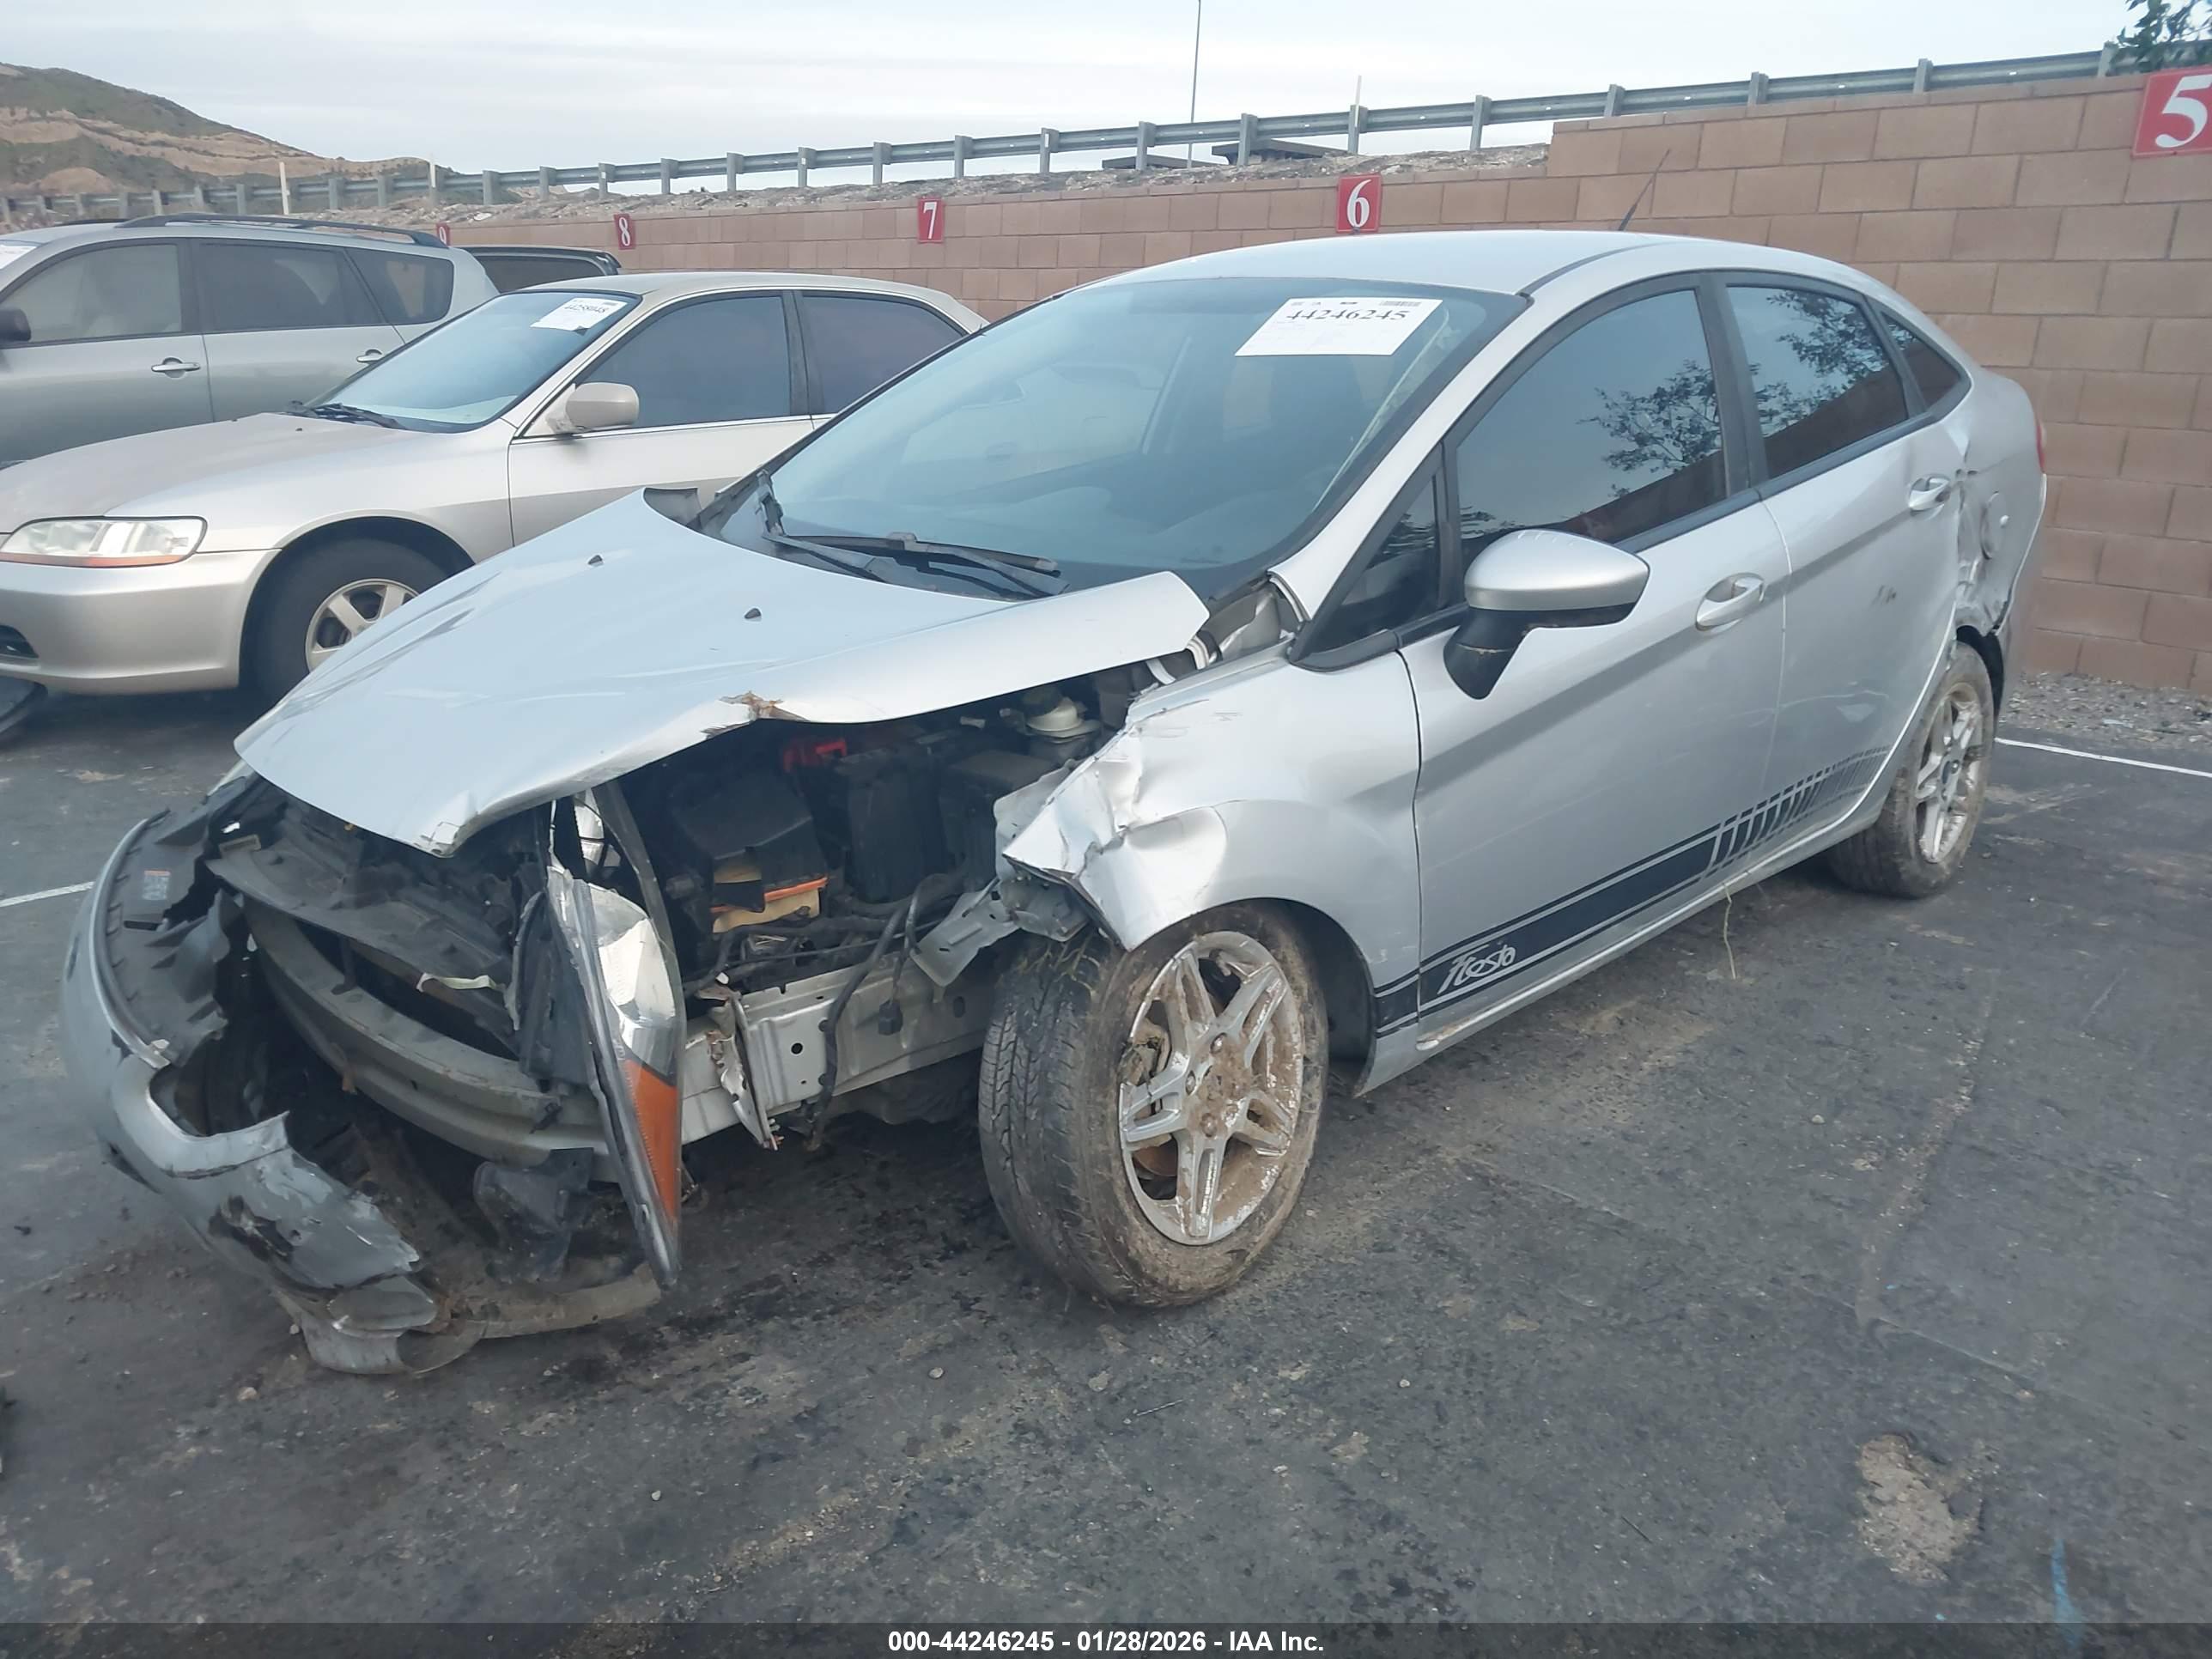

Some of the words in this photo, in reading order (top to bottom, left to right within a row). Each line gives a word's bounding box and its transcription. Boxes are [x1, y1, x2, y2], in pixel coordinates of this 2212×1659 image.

[2155, 73, 2212, 149] 5
[923, 201, 938, 240] 7
[1346, 179, 1372, 228] 6
[619, 216, 631, 246] 8
[1286, 309, 1411, 320] 44246245
[1437, 944, 1516, 995] Fiesta
